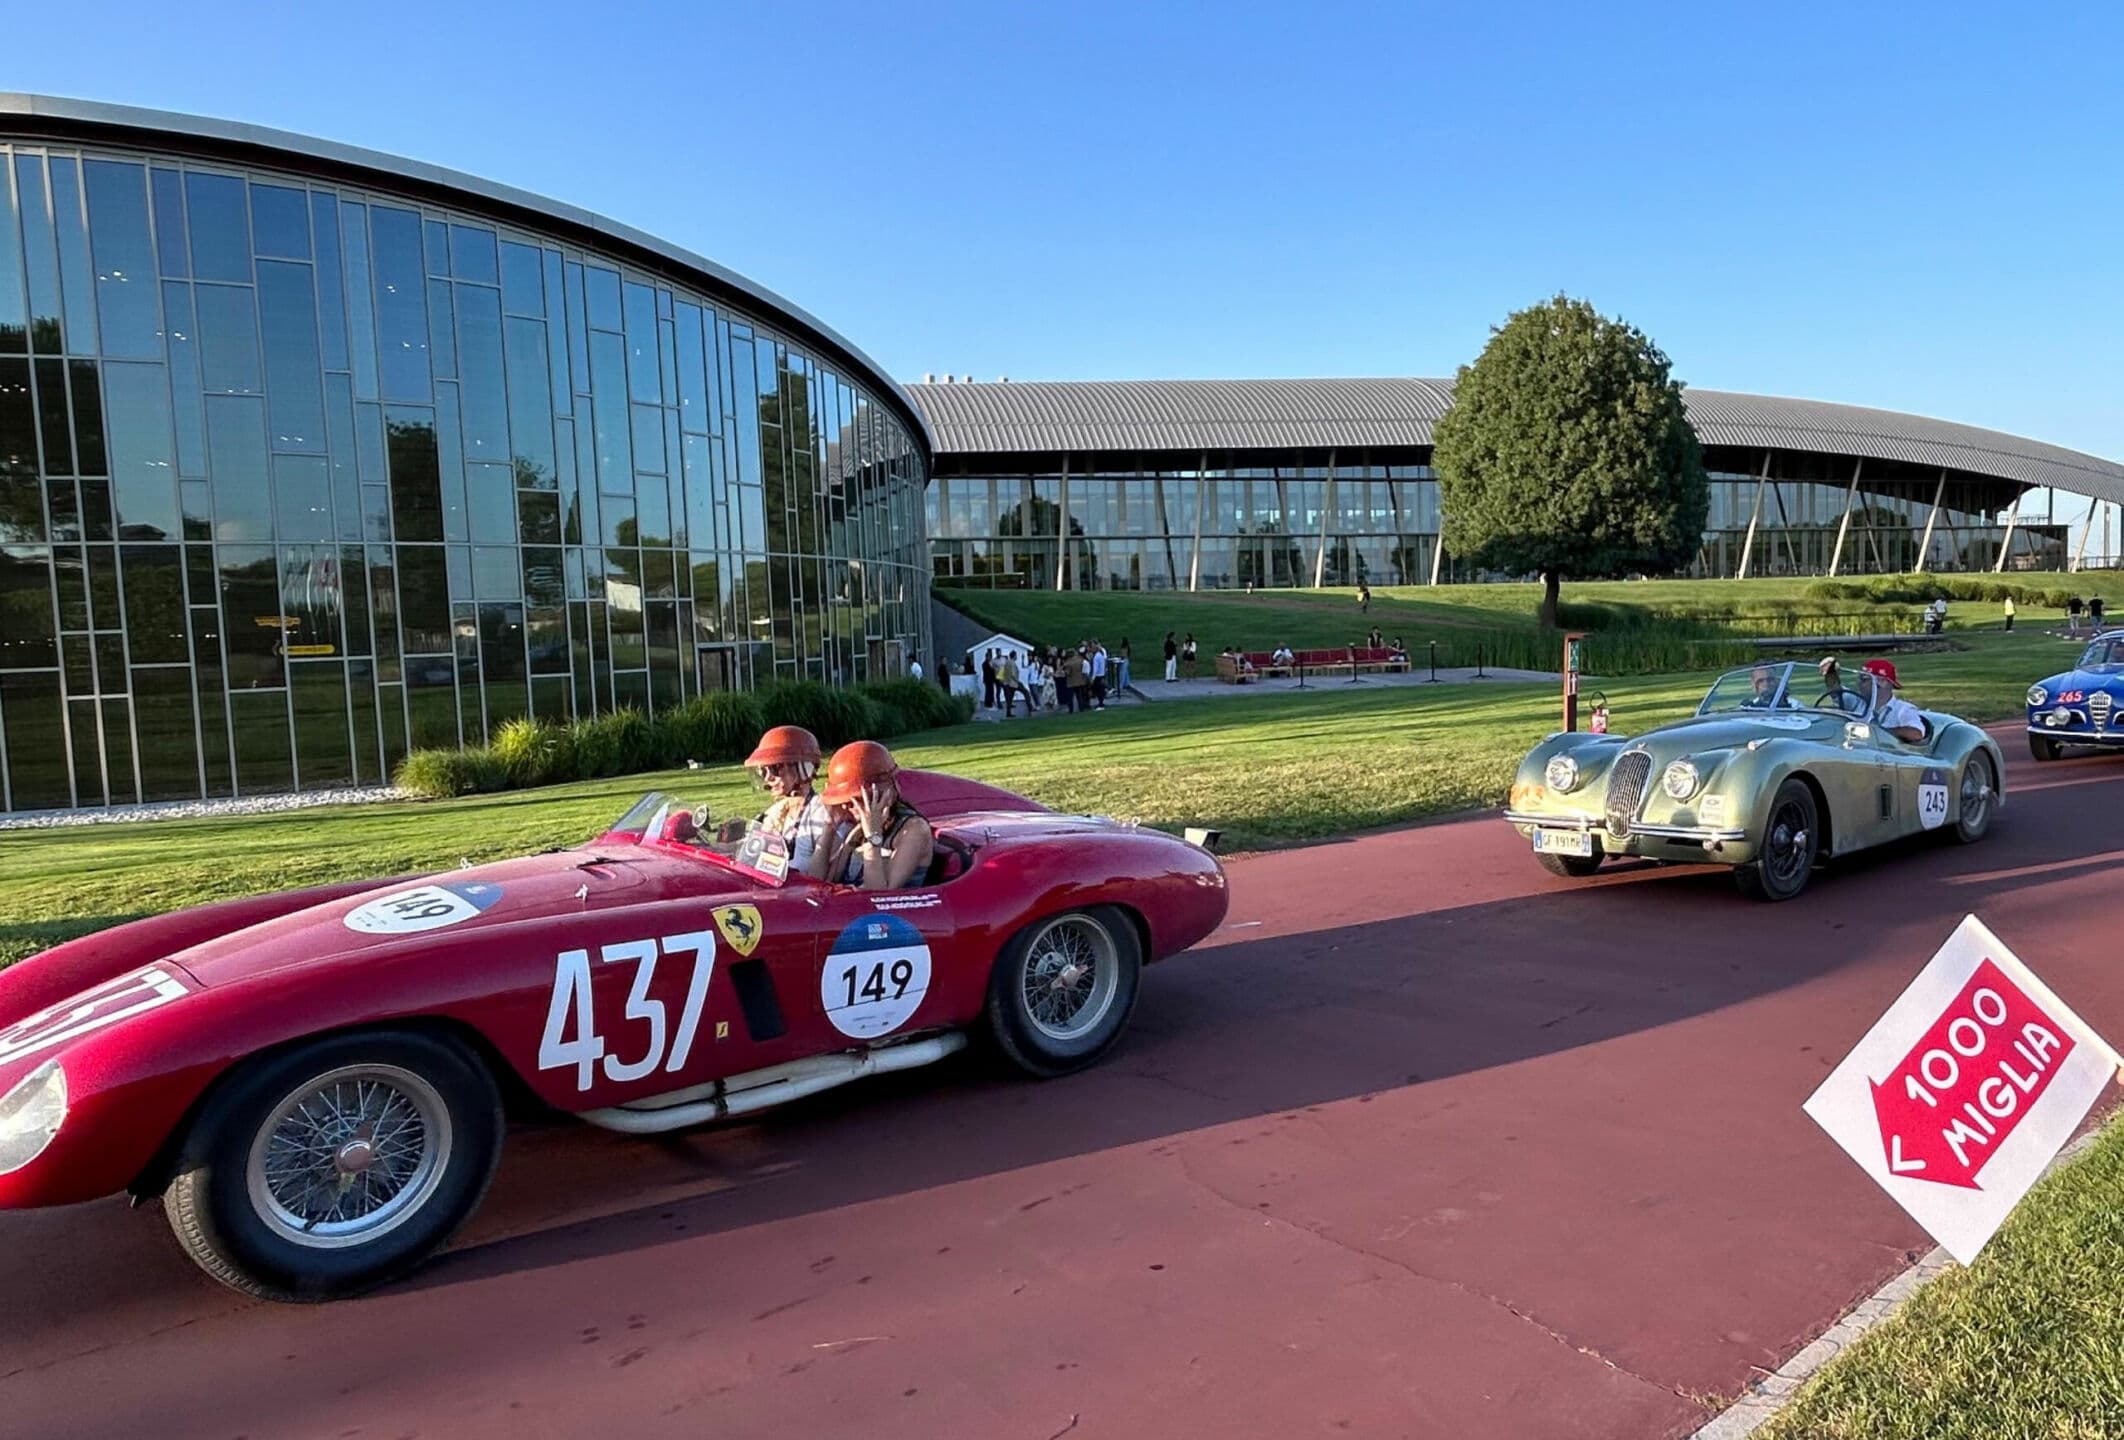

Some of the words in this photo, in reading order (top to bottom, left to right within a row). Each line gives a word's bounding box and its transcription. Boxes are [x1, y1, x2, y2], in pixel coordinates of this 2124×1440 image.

[2057, 690, 2083, 703] 265
[1925, 790, 1945, 813] 243
[380, 892, 455, 921] 149
[842, 959, 914, 1007] 149
[538, 930, 717, 1092] 437
[1904, 988, 2007, 1107] 1000
[1942, 1022, 2061, 1168] MIGLIA
